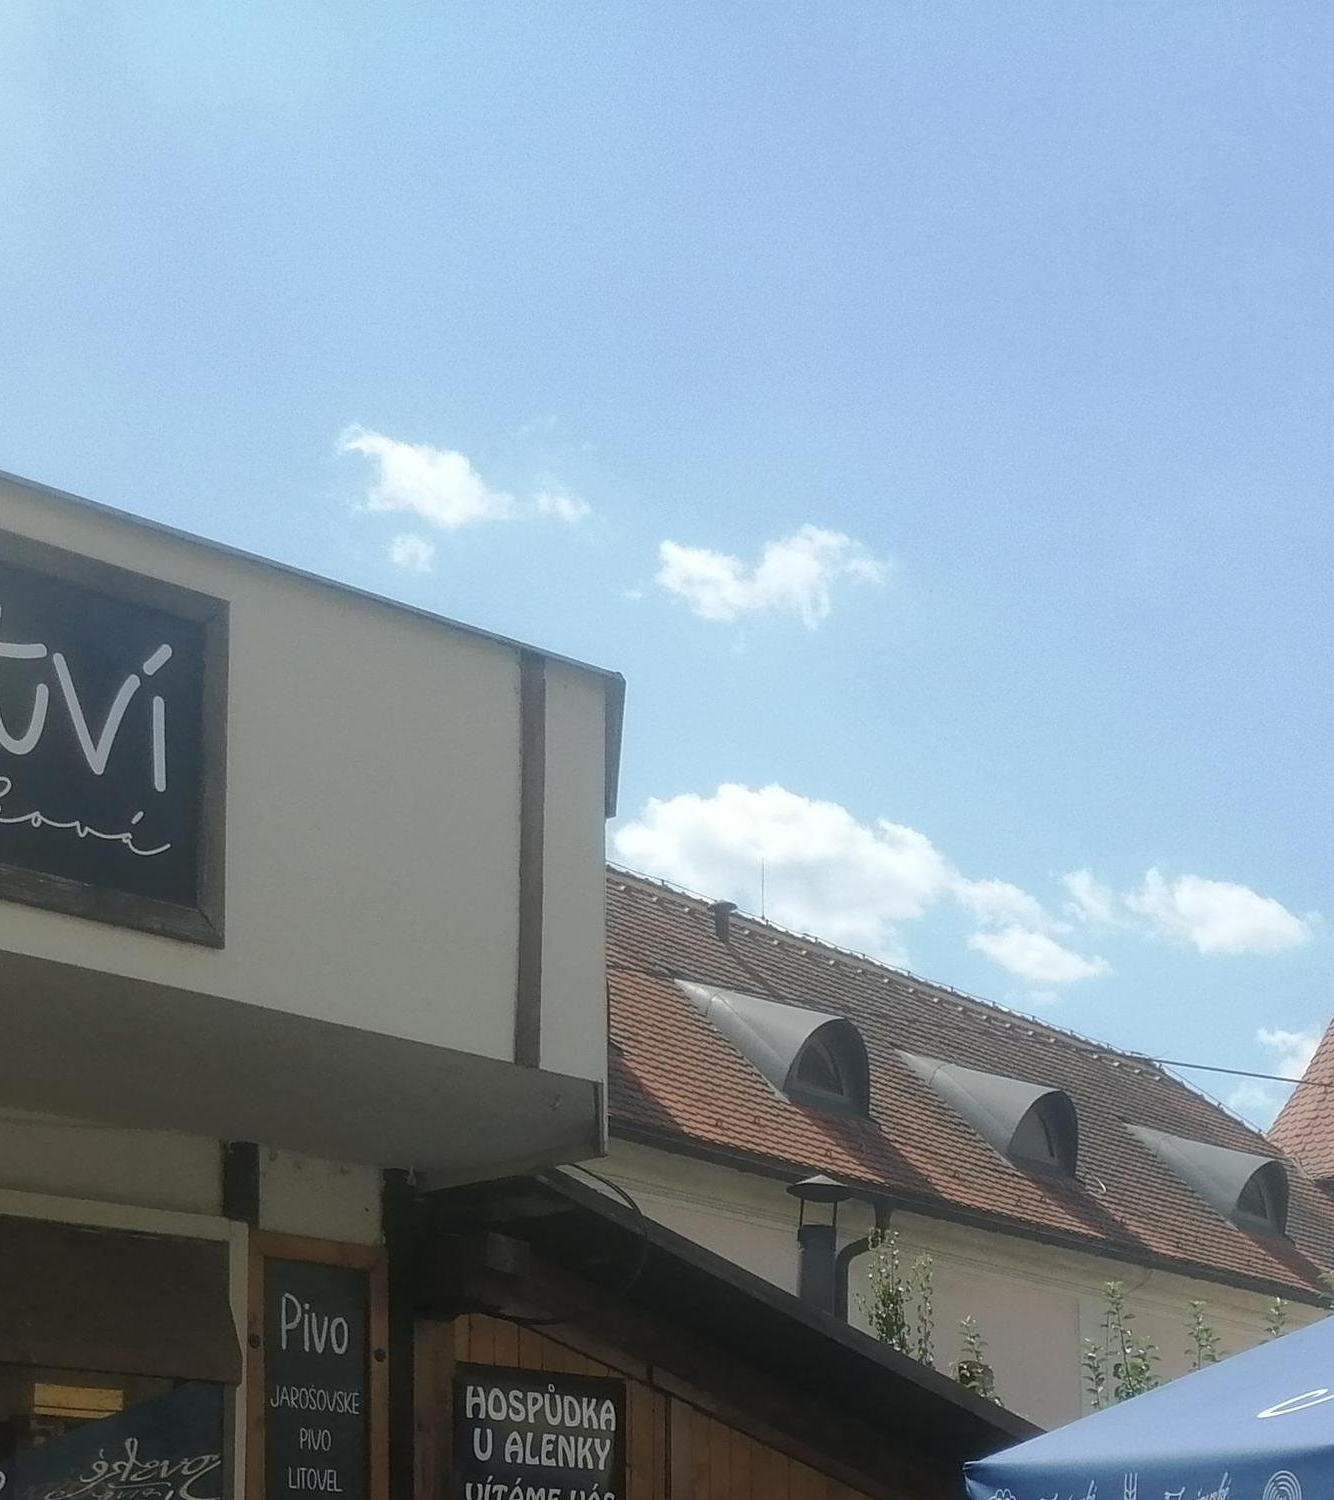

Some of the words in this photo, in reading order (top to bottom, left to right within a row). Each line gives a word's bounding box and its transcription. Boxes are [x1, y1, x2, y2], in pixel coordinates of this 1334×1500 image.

[466, 1383, 616, 1431] HOSPŮDKA
[299, 1427, 332, 1452] PIVO
[473, 1427, 493, 1461] U
[504, 1430, 611, 1470] ALENKY
[288, 1466, 344, 1493] LITOVEL
